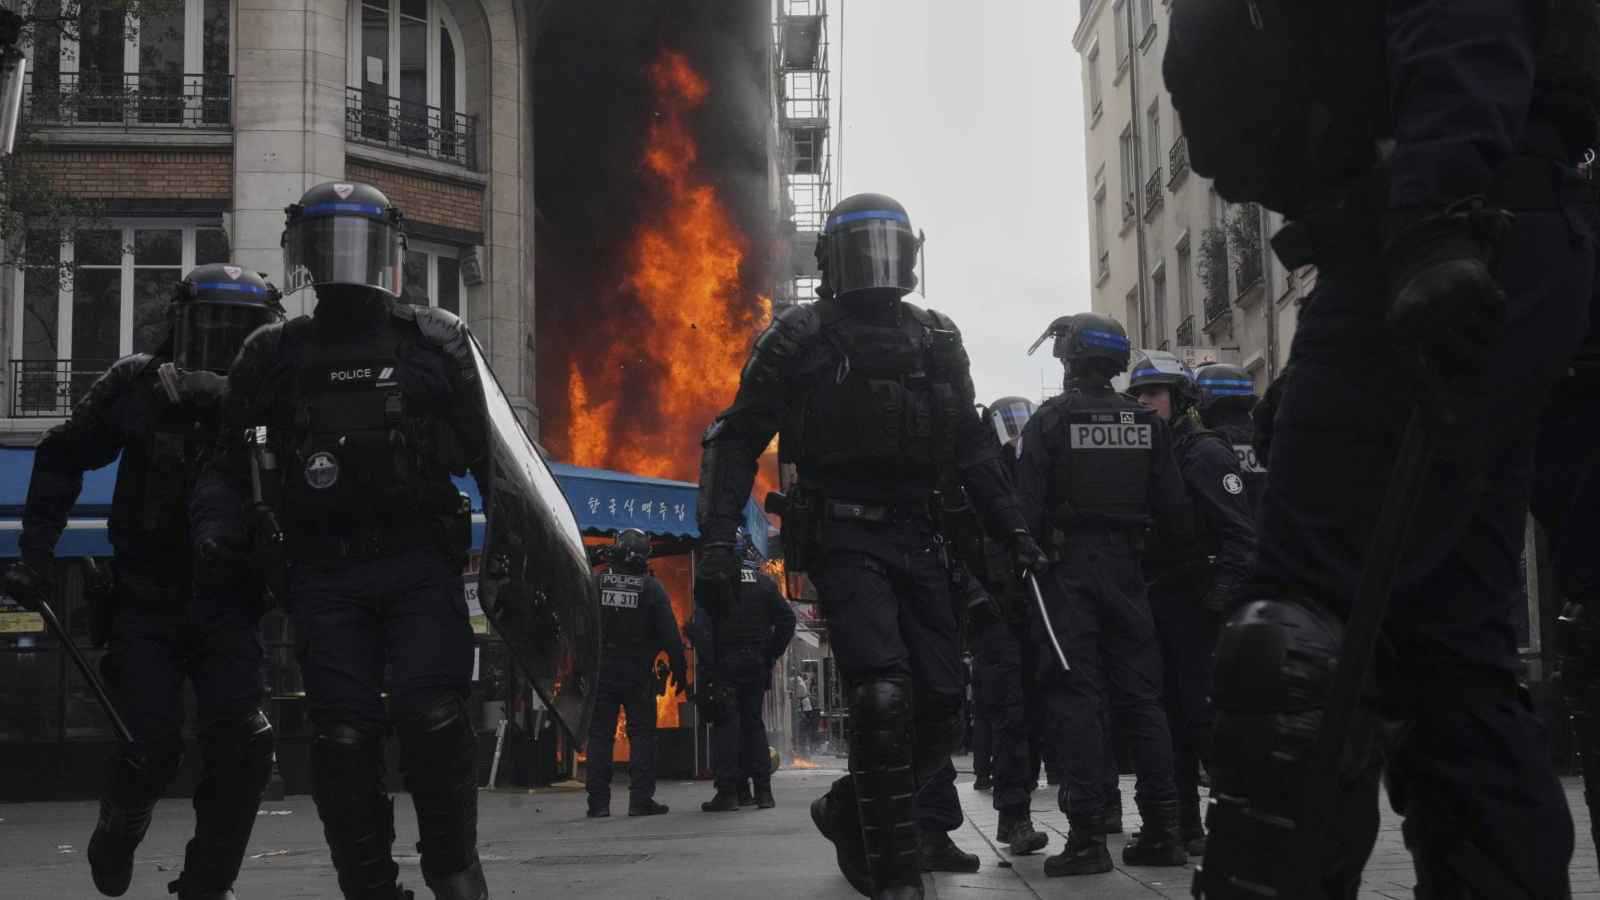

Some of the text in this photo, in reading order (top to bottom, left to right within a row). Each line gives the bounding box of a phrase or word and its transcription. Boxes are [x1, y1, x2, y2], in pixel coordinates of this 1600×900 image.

[329, 368, 371, 381] POLICE
[1079, 426, 1149, 446] POLICE
[603, 575, 641, 587] POLICE
[603, 592, 637, 607] TX 311
